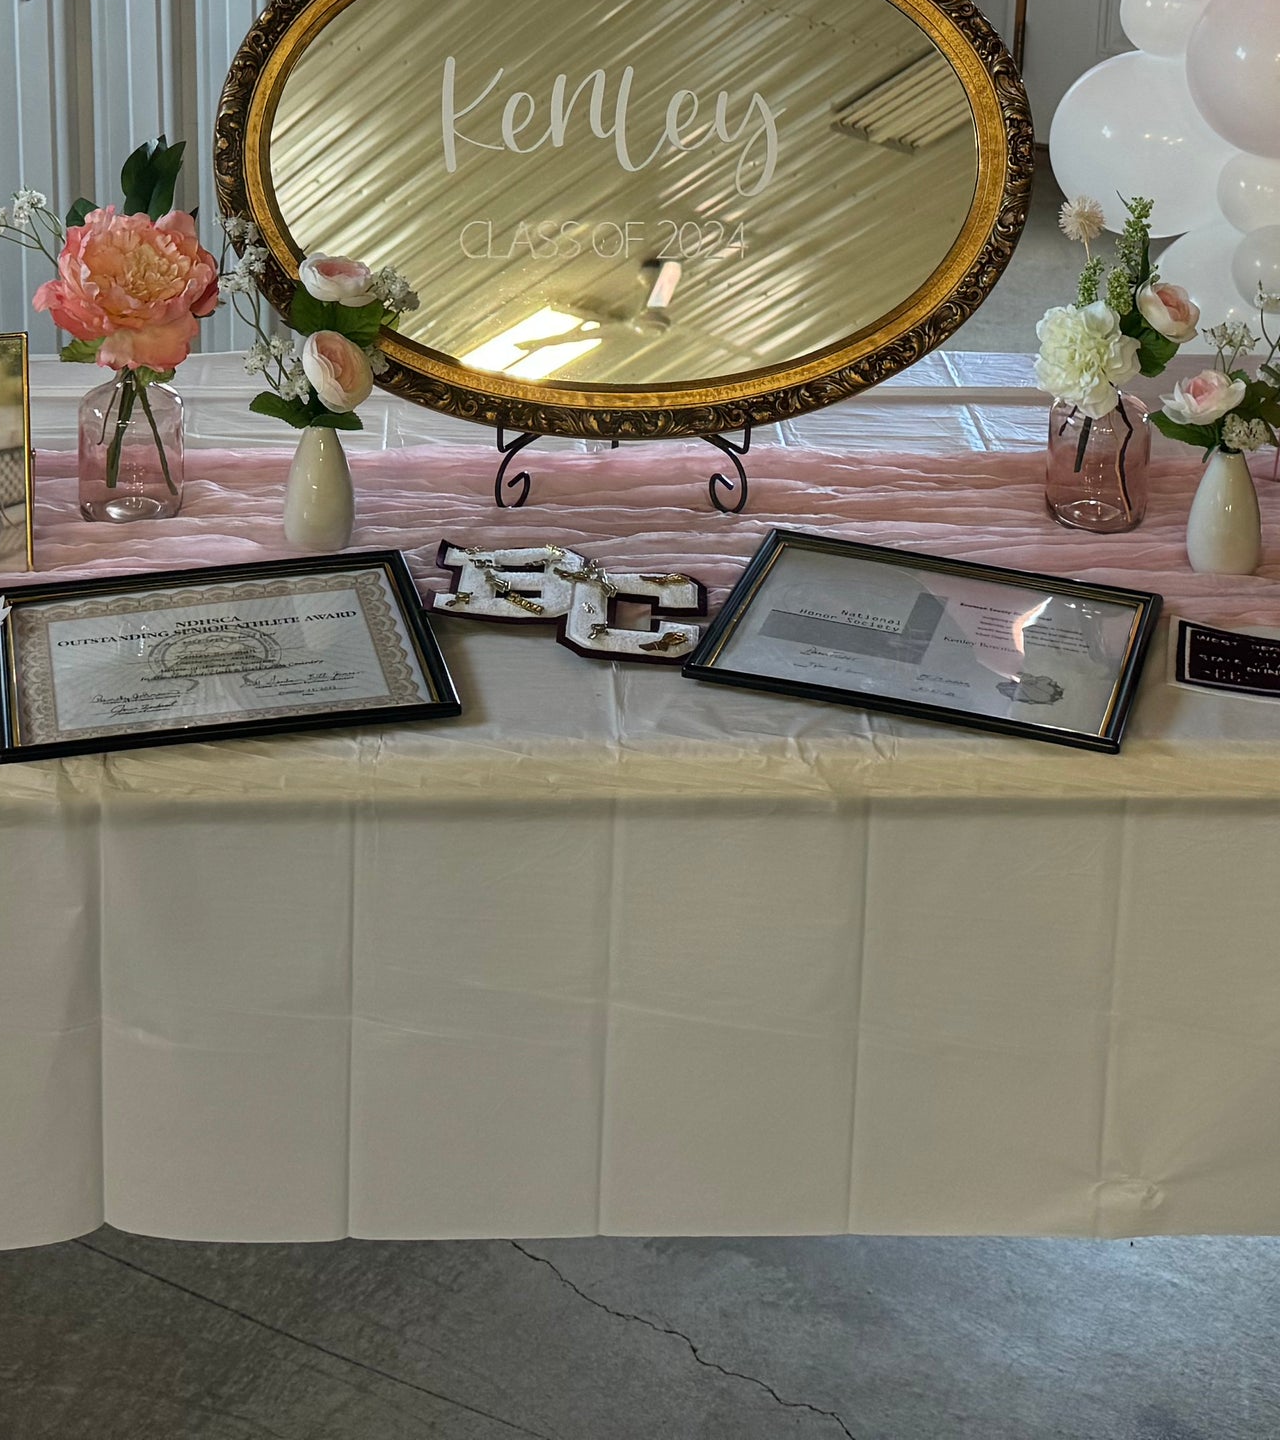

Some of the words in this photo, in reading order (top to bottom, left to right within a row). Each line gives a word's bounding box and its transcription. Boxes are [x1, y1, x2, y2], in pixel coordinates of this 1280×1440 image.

[440, 56, 786, 196] Kenley
[459, 220, 579, 260] CLASS
[592, 221, 645, 260] OF
[656, 220, 749, 260] 2024
[57, 631, 169, 647] OUTSTANDING
[173, 624, 228, 637] SENIOR
[236, 616, 300, 629] ATHLETE
[304, 610, 357, 622] AWARD
[175, 615, 241, 628] NDHSCA
[799, 608, 837, 620] Honor
[846, 617, 900, 632] Society
[841, 610, 901, 626] National
